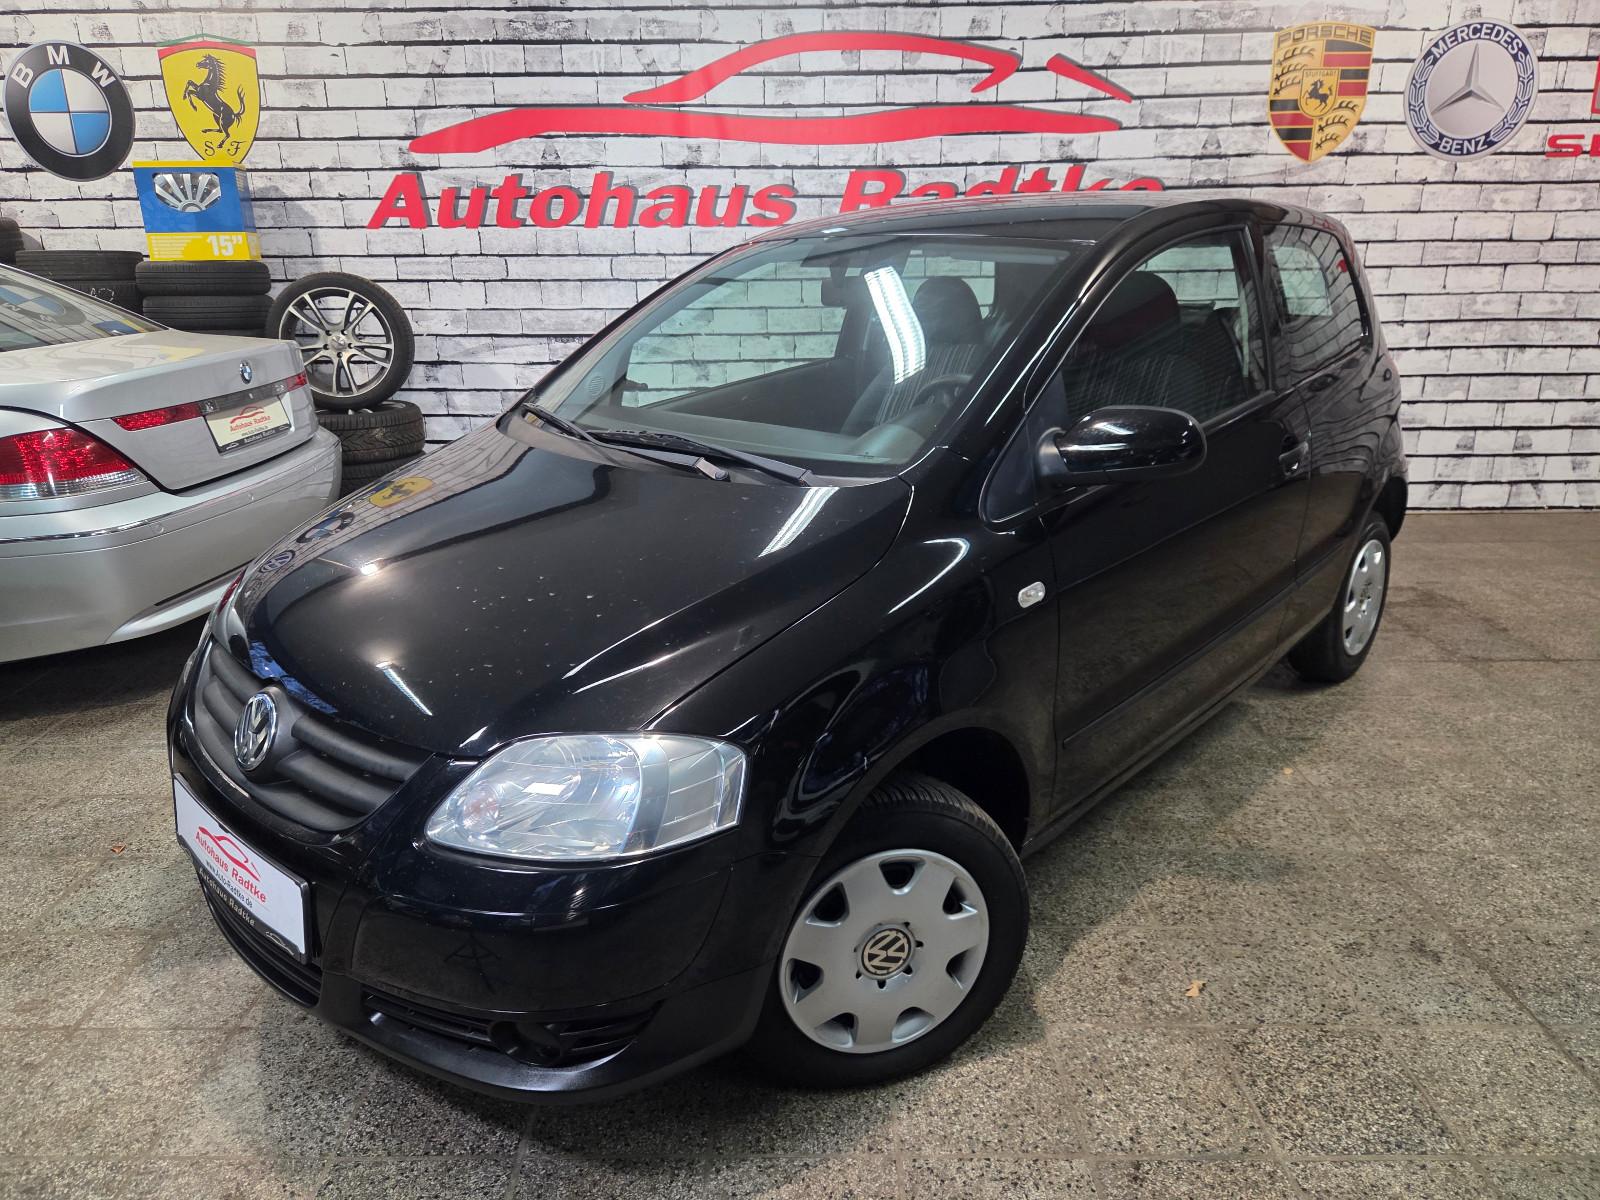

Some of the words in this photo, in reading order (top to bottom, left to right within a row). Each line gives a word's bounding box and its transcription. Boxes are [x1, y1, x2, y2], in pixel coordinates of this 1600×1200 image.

[1278, 24, 1372, 48] PORSCHE
[1431, 23, 1523, 61] MERCEDES
[11, 45, 116, 89] BMW
[1440, 135, 1489, 155] BENZ
[367, 170, 798, 230] Autohaus
[195, 831, 229, 872] Autohaus
[231, 867, 267, 903] Radtke
[229, 898, 256, 926] Radtke
